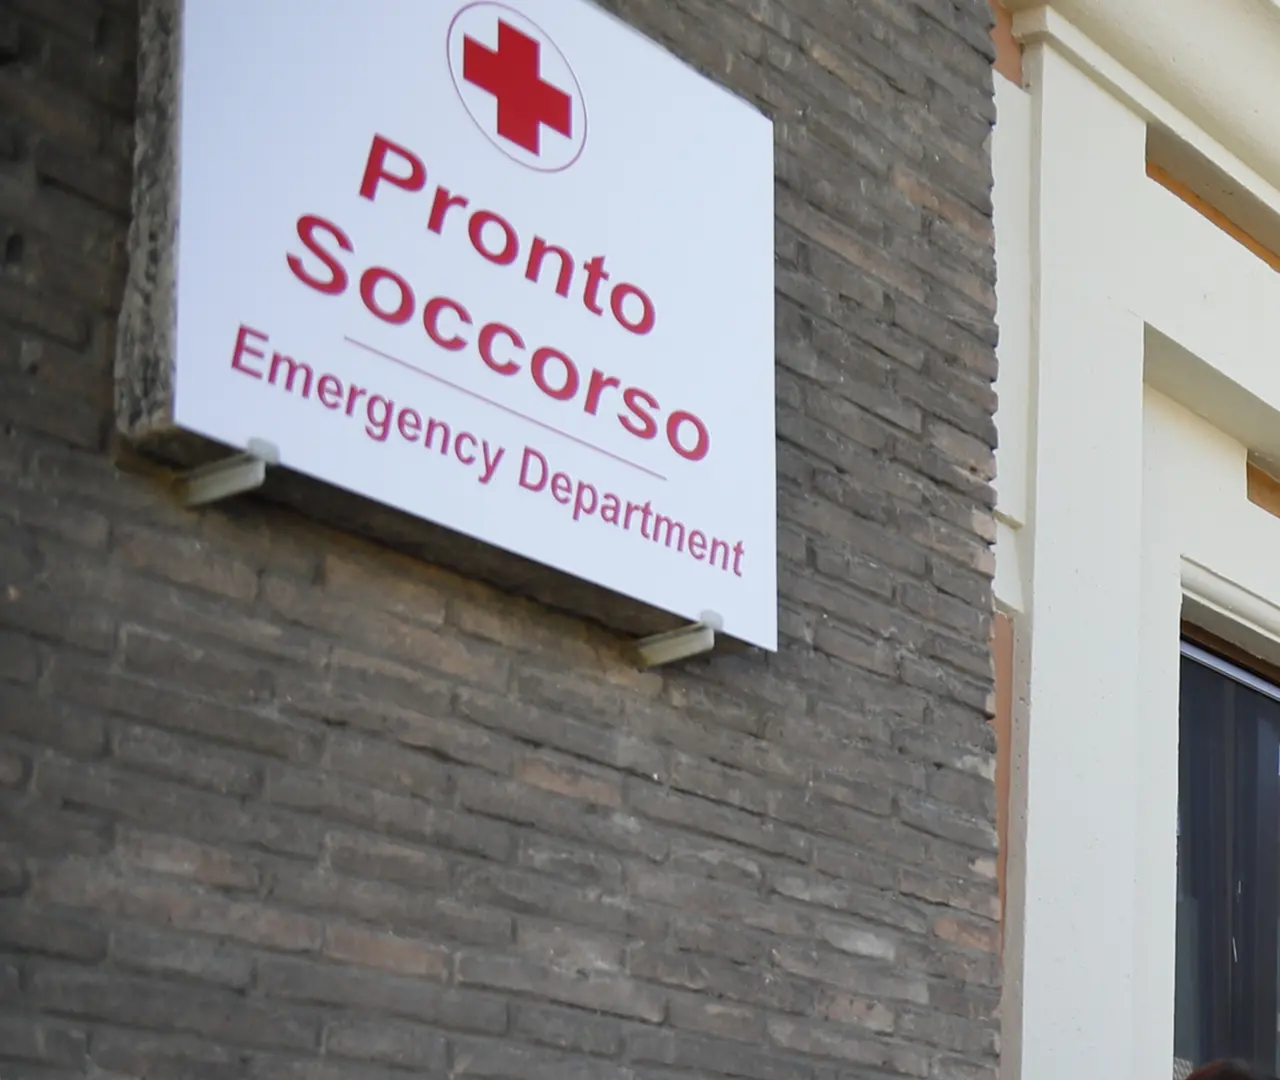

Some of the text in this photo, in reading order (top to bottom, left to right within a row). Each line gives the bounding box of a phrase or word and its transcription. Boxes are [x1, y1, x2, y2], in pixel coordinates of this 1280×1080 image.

[286, 214, 711, 462] Soccorso
[360, 133, 656, 336] Pronto
[231, 324, 745, 577] Emergency Department
